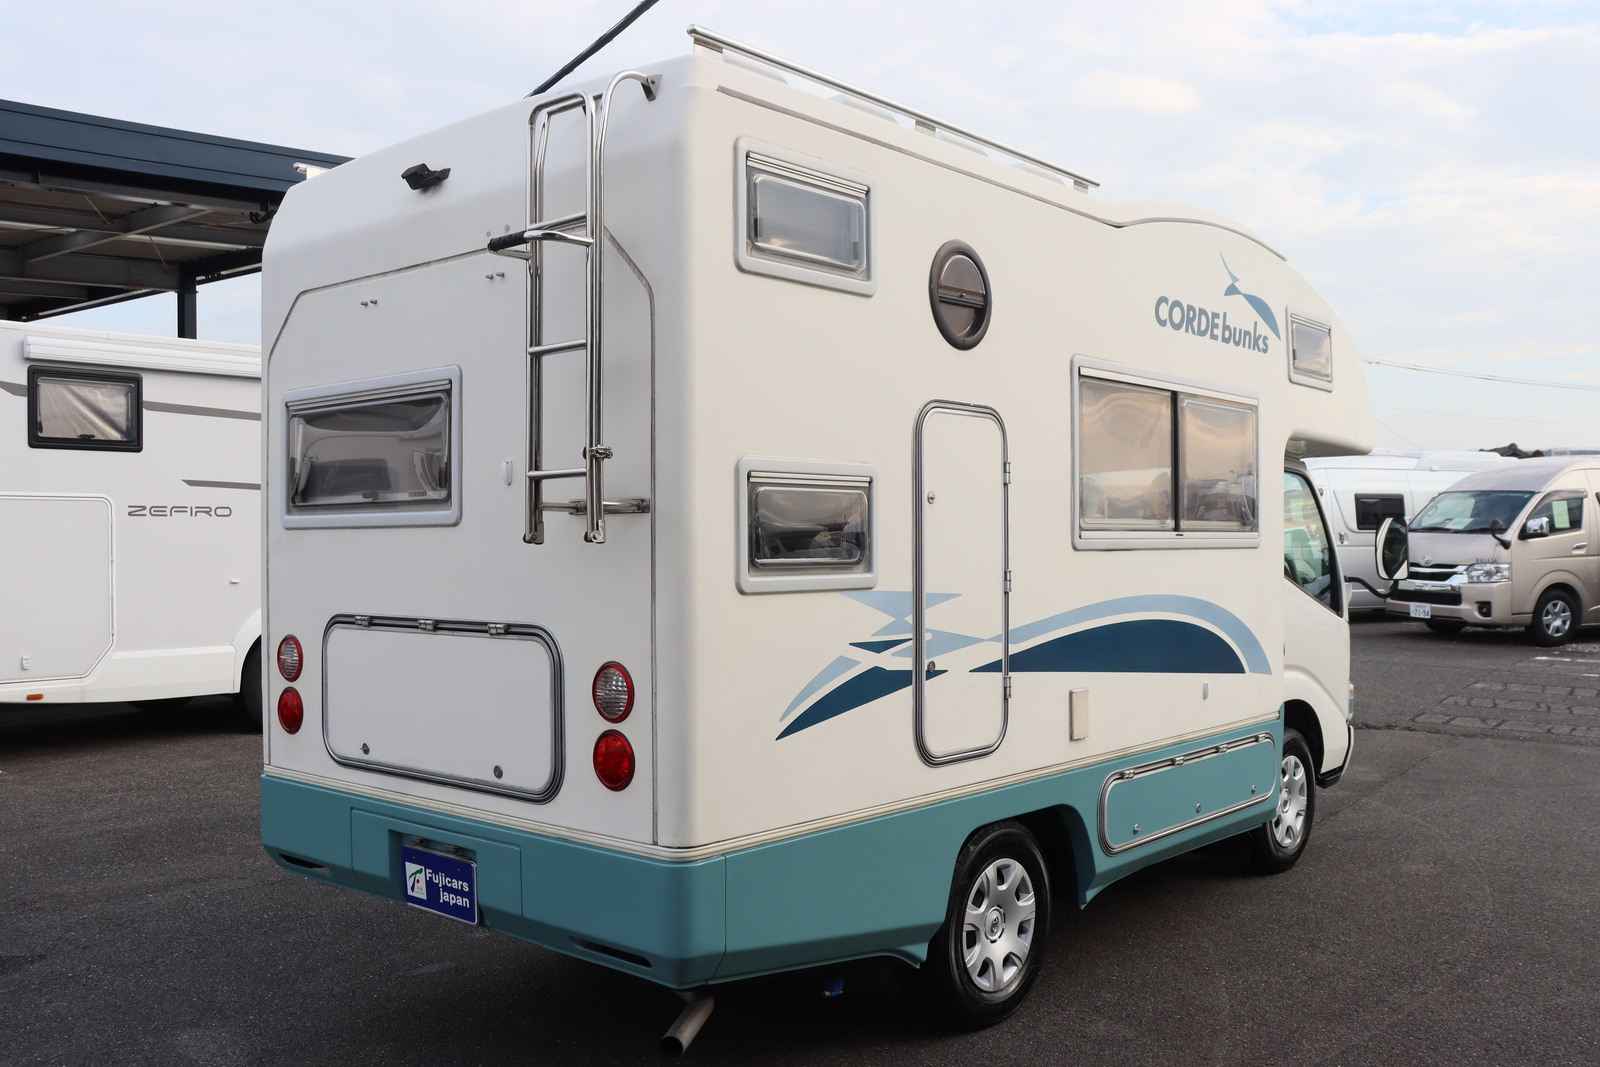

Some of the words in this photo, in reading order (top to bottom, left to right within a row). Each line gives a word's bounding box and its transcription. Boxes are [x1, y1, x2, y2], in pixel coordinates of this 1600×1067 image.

[127, 505, 232, 517] ZEFIRO
[425, 868, 469, 892] Fujicars
[440, 888, 469, 908] japan
